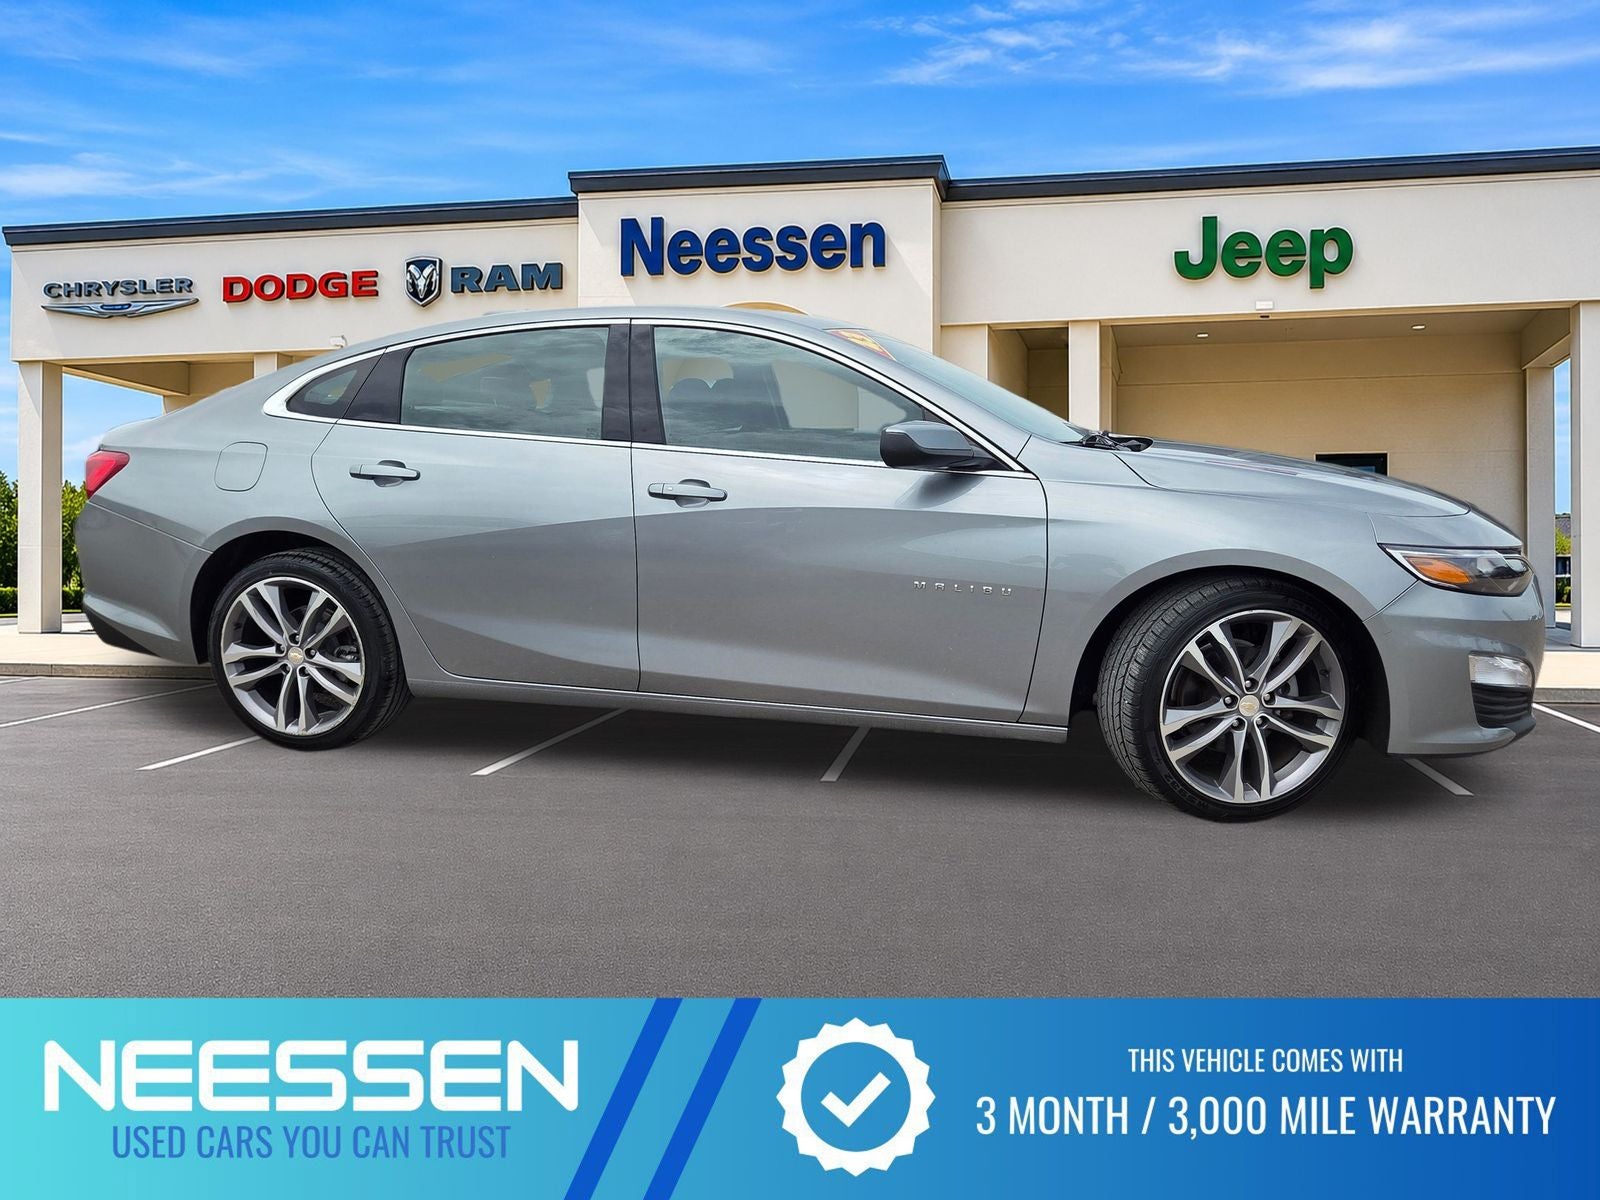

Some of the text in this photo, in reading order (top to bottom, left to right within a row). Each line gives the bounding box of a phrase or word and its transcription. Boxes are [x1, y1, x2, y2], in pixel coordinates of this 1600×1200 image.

[620, 216, 887, 277] Neessen
[1174, 215, 1355, 289] Jeep
[43, 277, 194, 299] CHRYSLER
[222, 270, 379, 303] DODGE
[450, 262, 563, 294] RAM
[913, 580, 1012, 596] MALIBU
